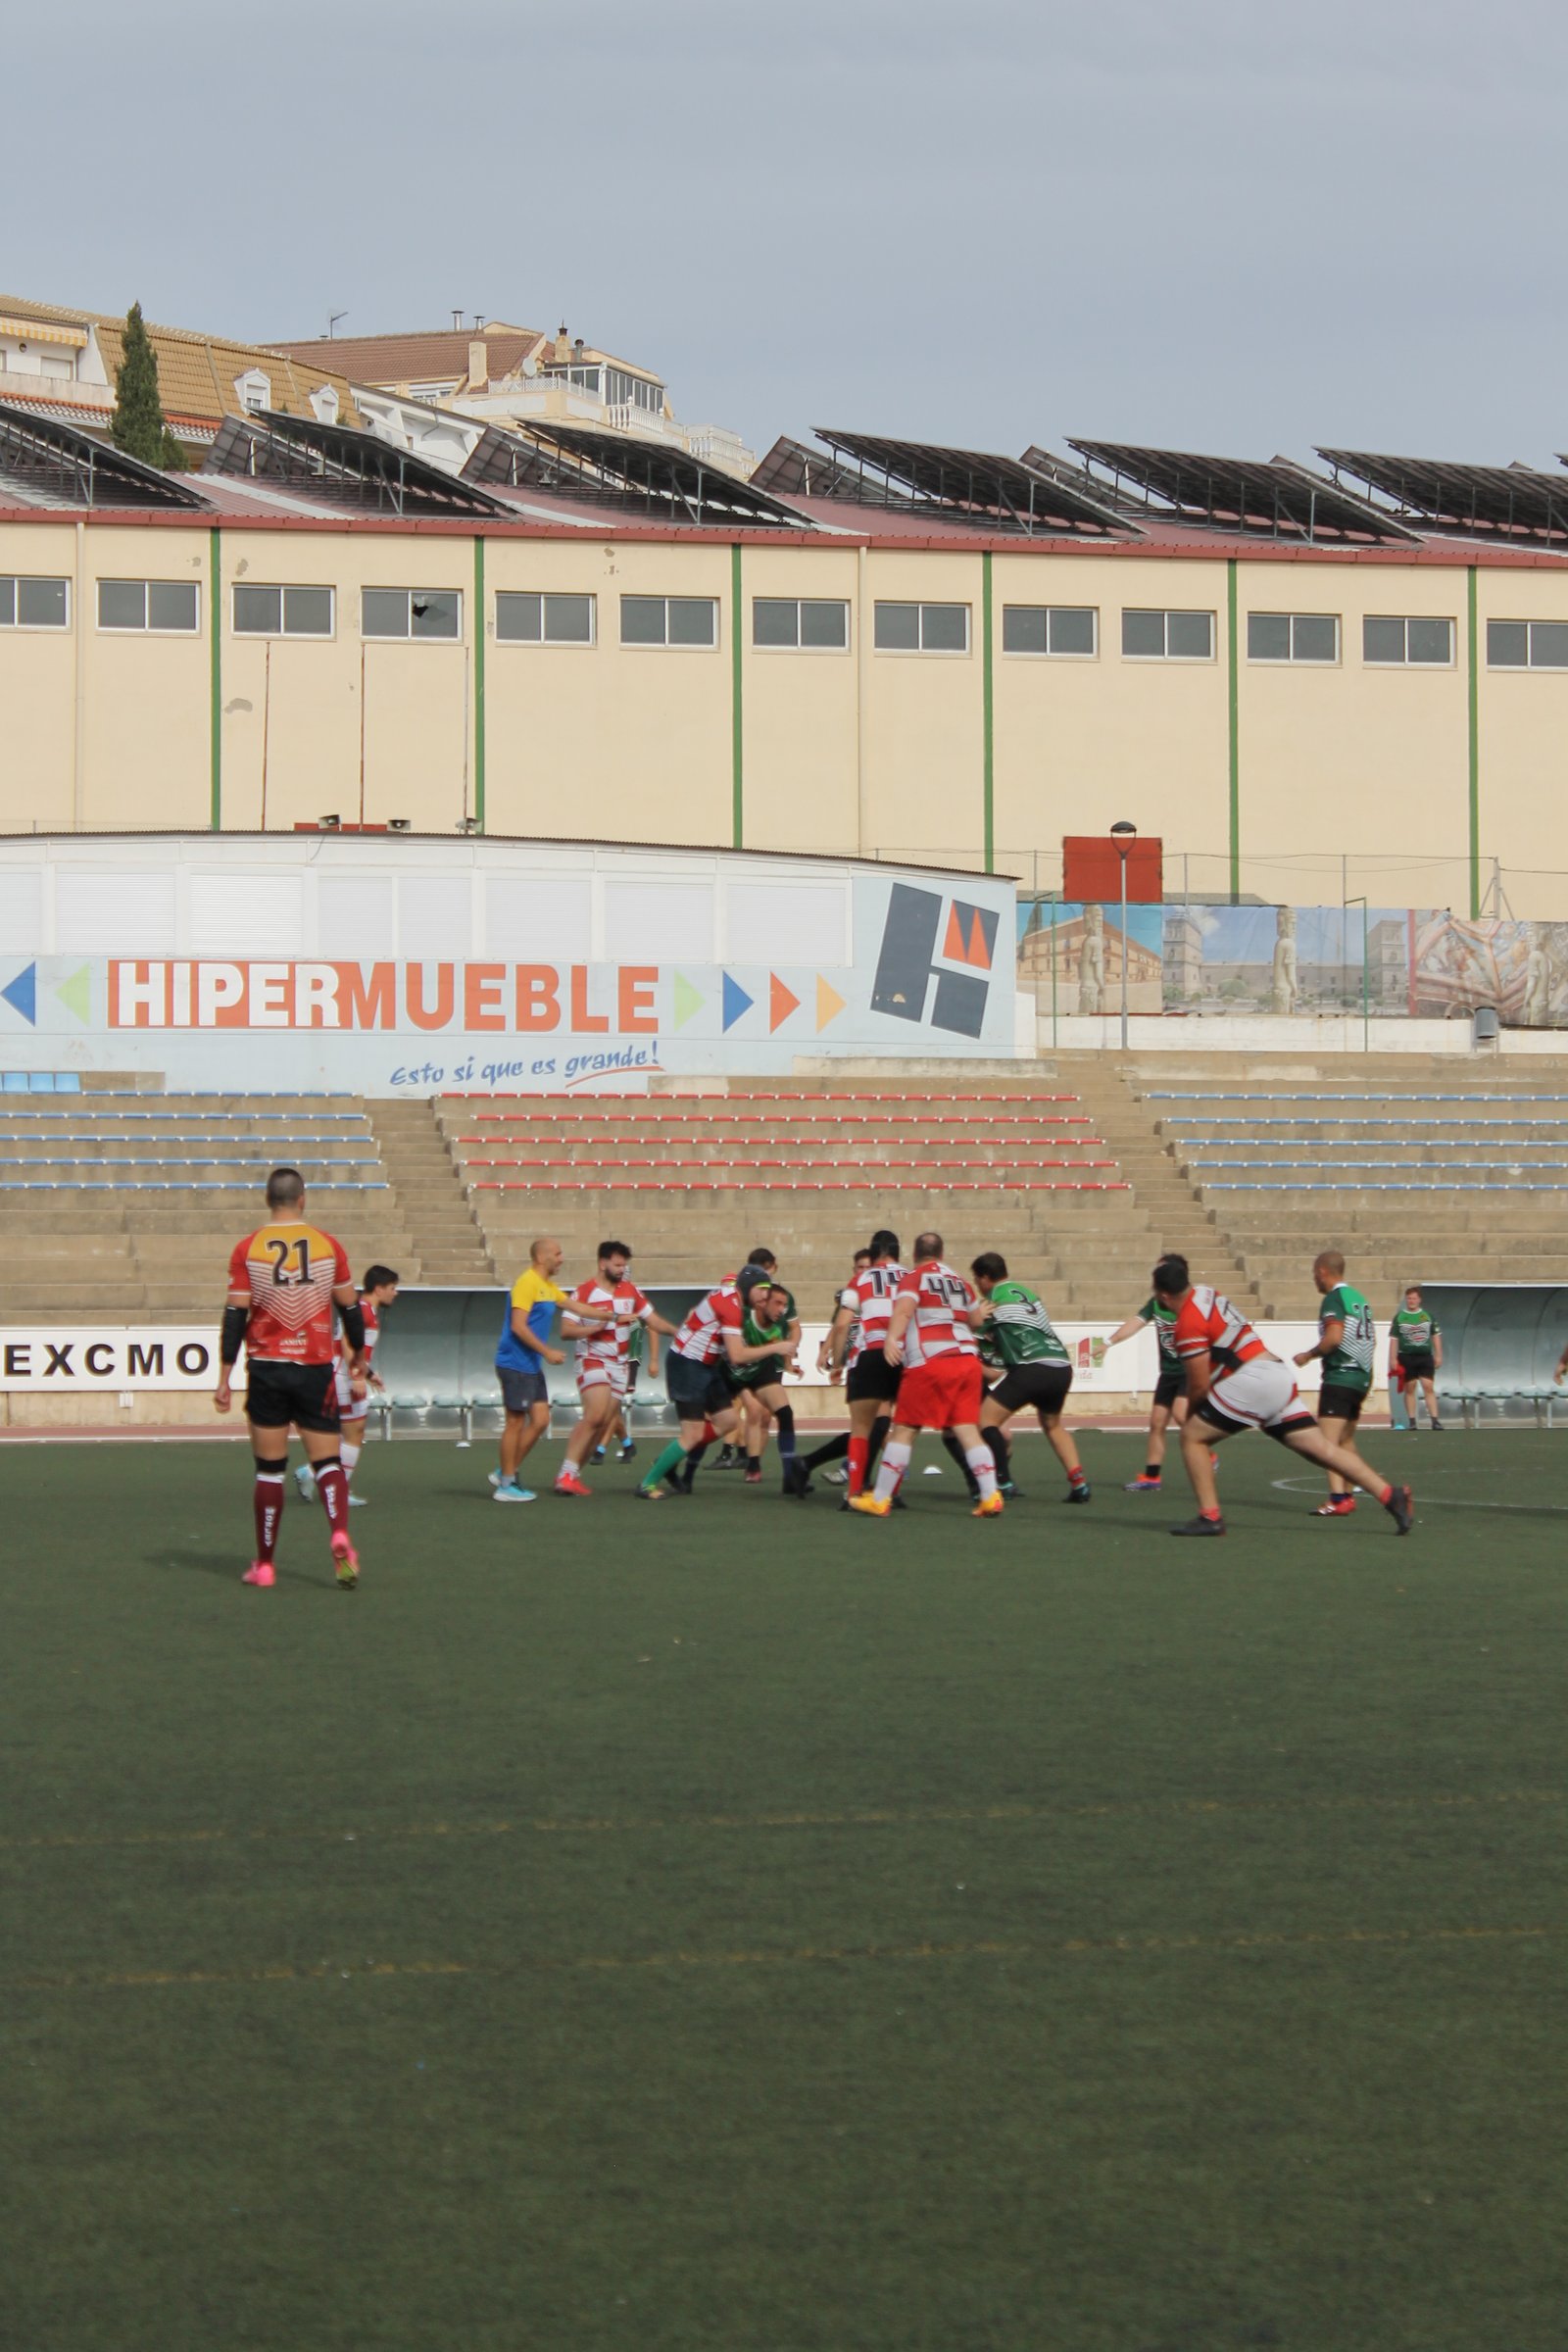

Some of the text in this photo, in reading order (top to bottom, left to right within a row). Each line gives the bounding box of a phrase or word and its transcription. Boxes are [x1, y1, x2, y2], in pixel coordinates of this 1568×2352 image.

[116, 961, 660, 1032] HIPERMUEBLE
[389, 1065, 445, 1085] Esto
[480, 1060, 523, 1087] que
[530, 1057, 557, 1075] es
[564, 1040, 659, 1078] grande!
[266, 1239, 316, 1287] 21
[927, 1276, 969, 1306] 44
[1010, 1289, 1038, 1314] 3
[4, 1343, 210, 1376] EXCMO
